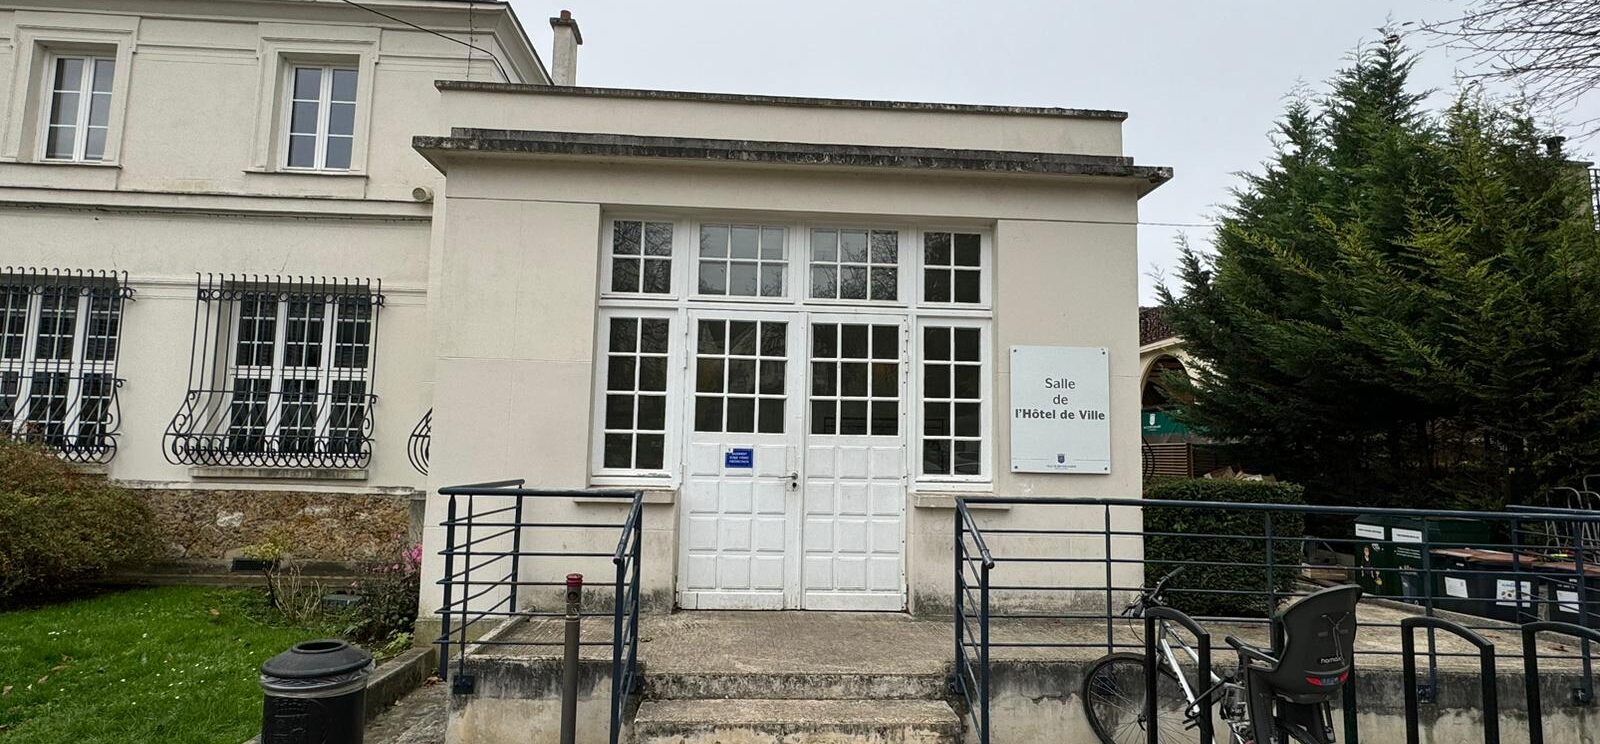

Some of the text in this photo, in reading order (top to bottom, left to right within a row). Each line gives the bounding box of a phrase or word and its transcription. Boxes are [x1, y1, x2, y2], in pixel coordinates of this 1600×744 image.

[1045, 377, 1075, 389] Salle
[1053, 394, 1068, 405] de
[1015, 408, 1105, 420] l'Hôtel de Ville
